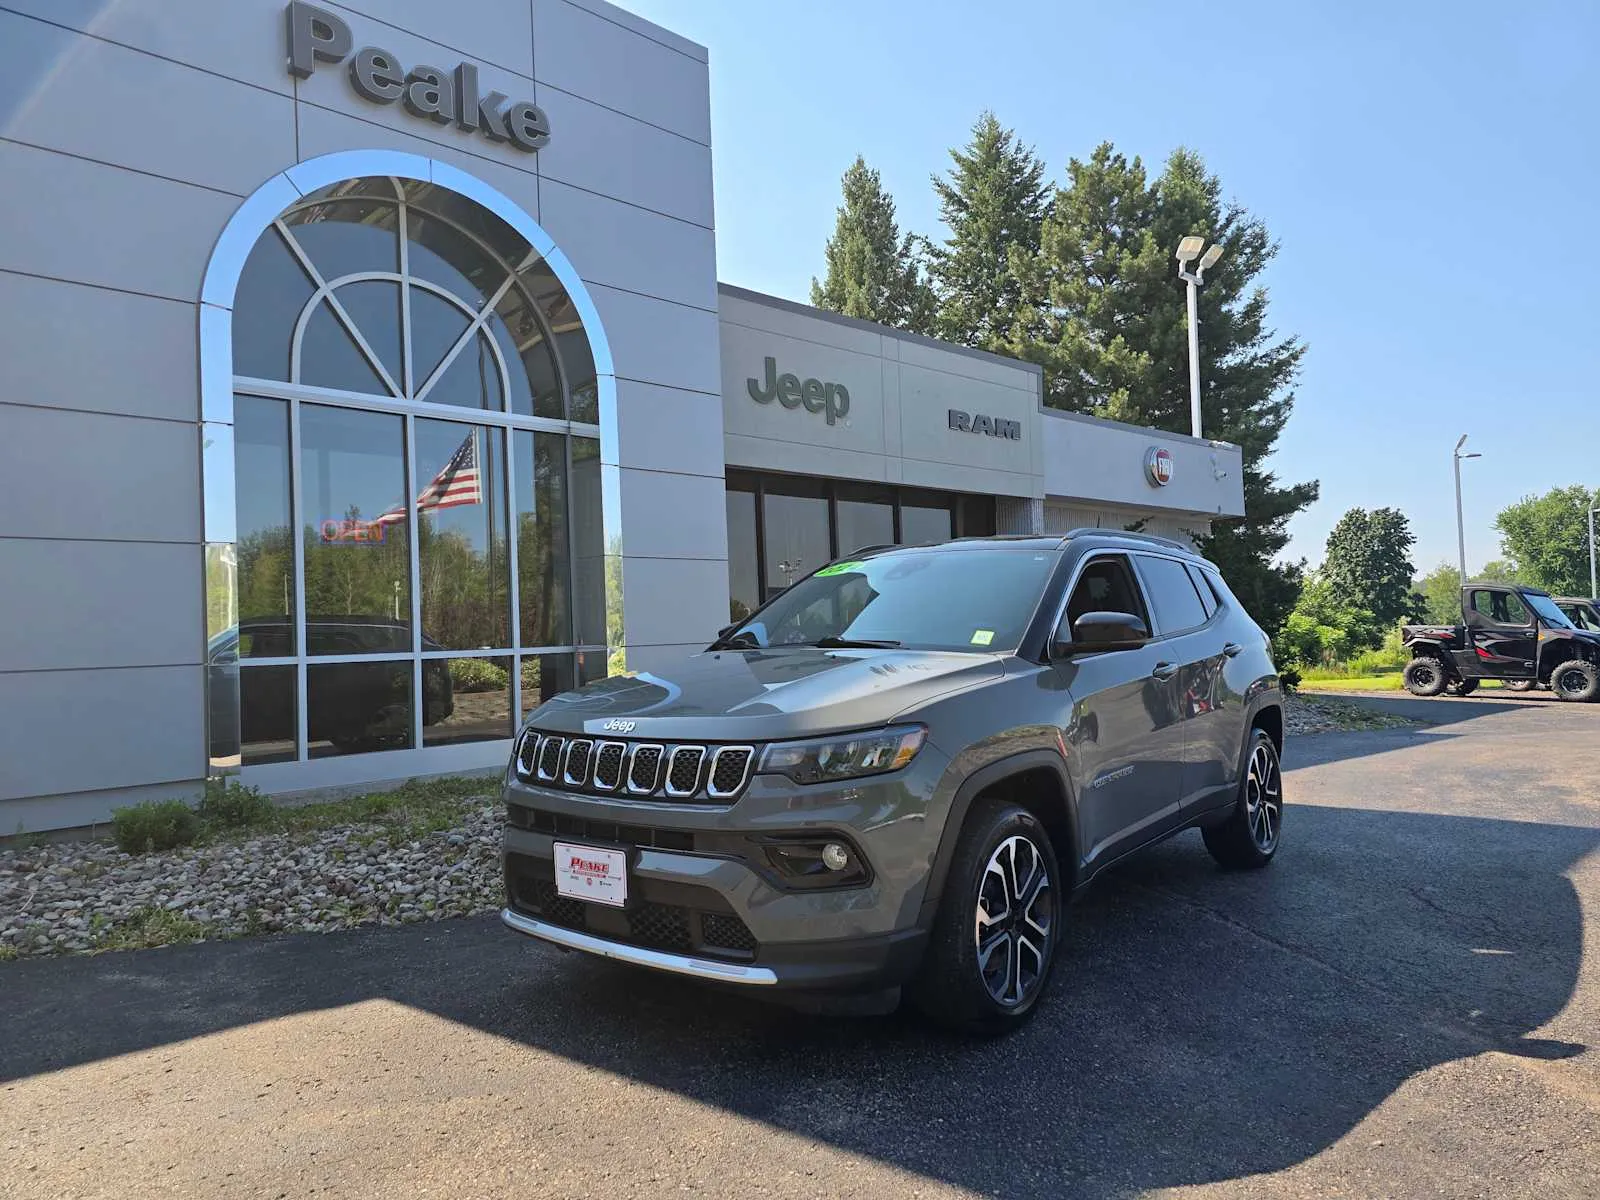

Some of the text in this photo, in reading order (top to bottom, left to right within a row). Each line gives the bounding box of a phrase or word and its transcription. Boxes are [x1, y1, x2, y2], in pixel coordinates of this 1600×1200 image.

[286, 0, 551, 152] Peake
[746, 356, 850, 426] Jeep
[948, 409, 1021, 441] RAM
[321, 519, 384, 543] OPEN
[603, 718, 636, 734] Jeep
